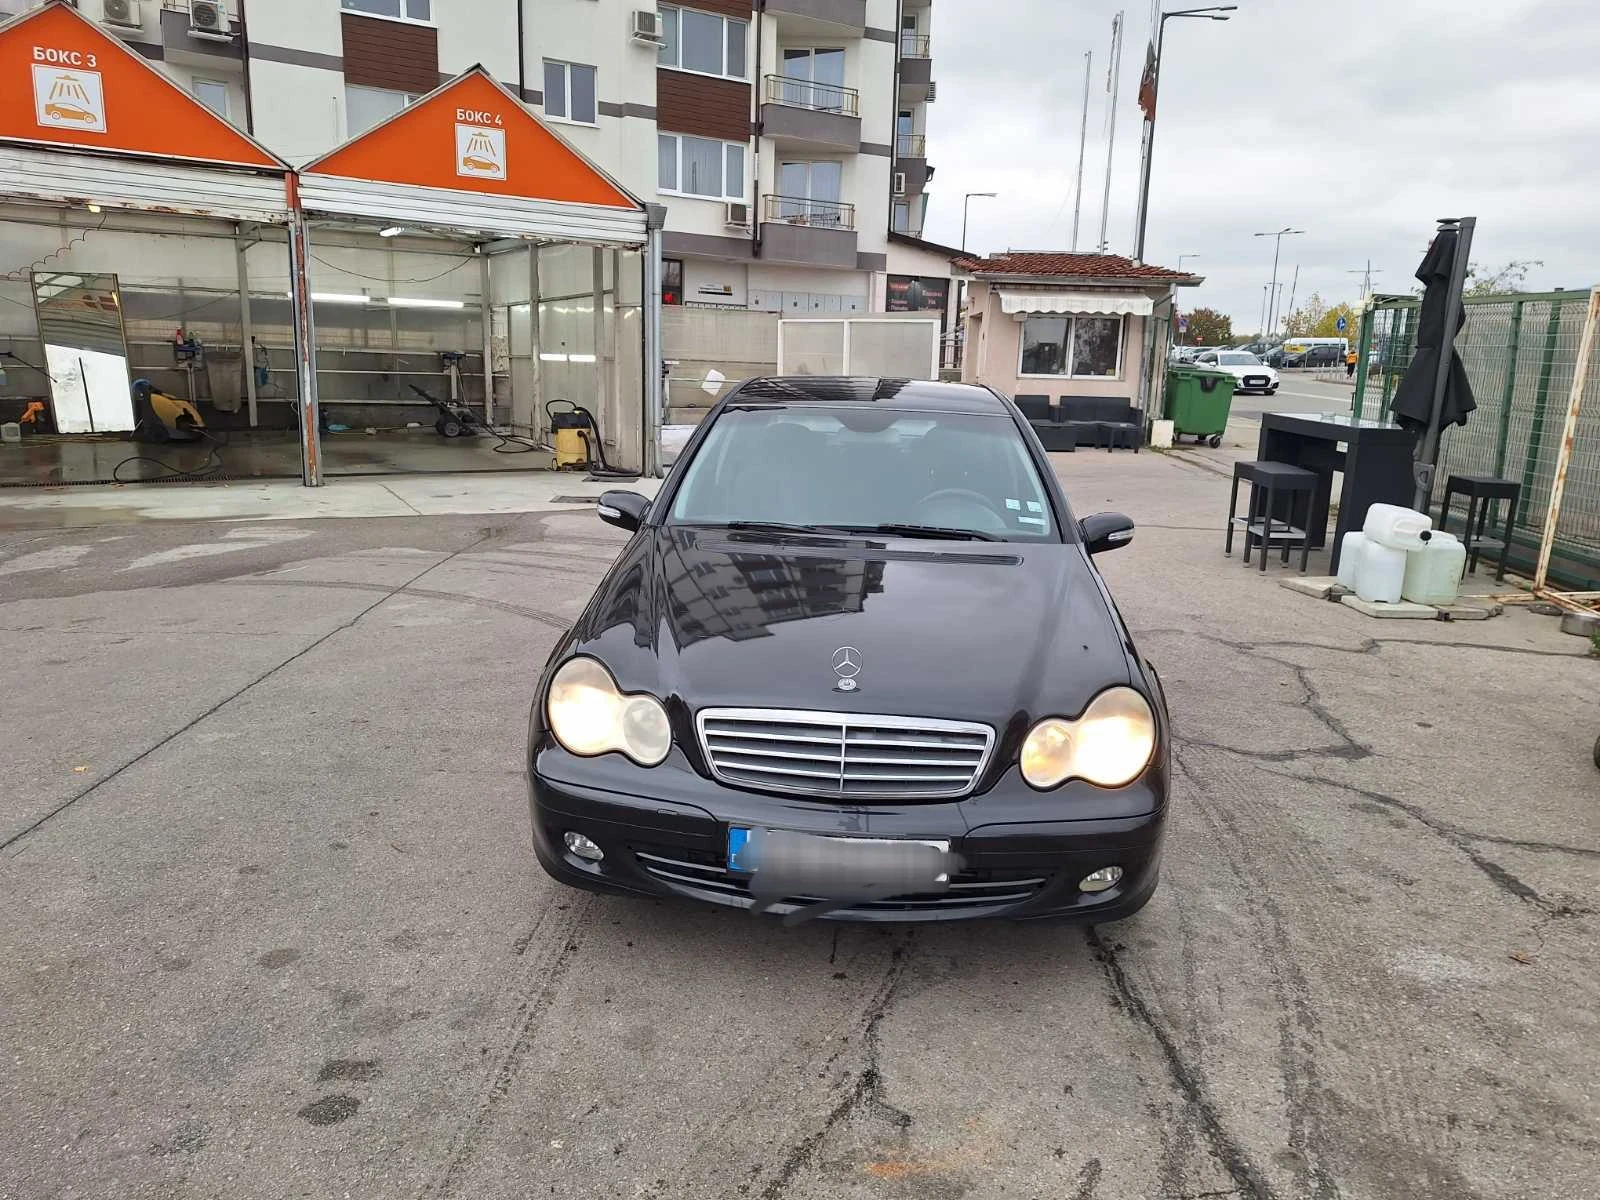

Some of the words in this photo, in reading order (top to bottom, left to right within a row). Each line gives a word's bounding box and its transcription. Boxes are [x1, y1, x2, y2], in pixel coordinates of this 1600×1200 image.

[33, 46, 82, 66] БОКС
[86, 54, 97, 68] 3
[456, 108, 492, 124] БОКС
[494, 114, 503, 126] 4
